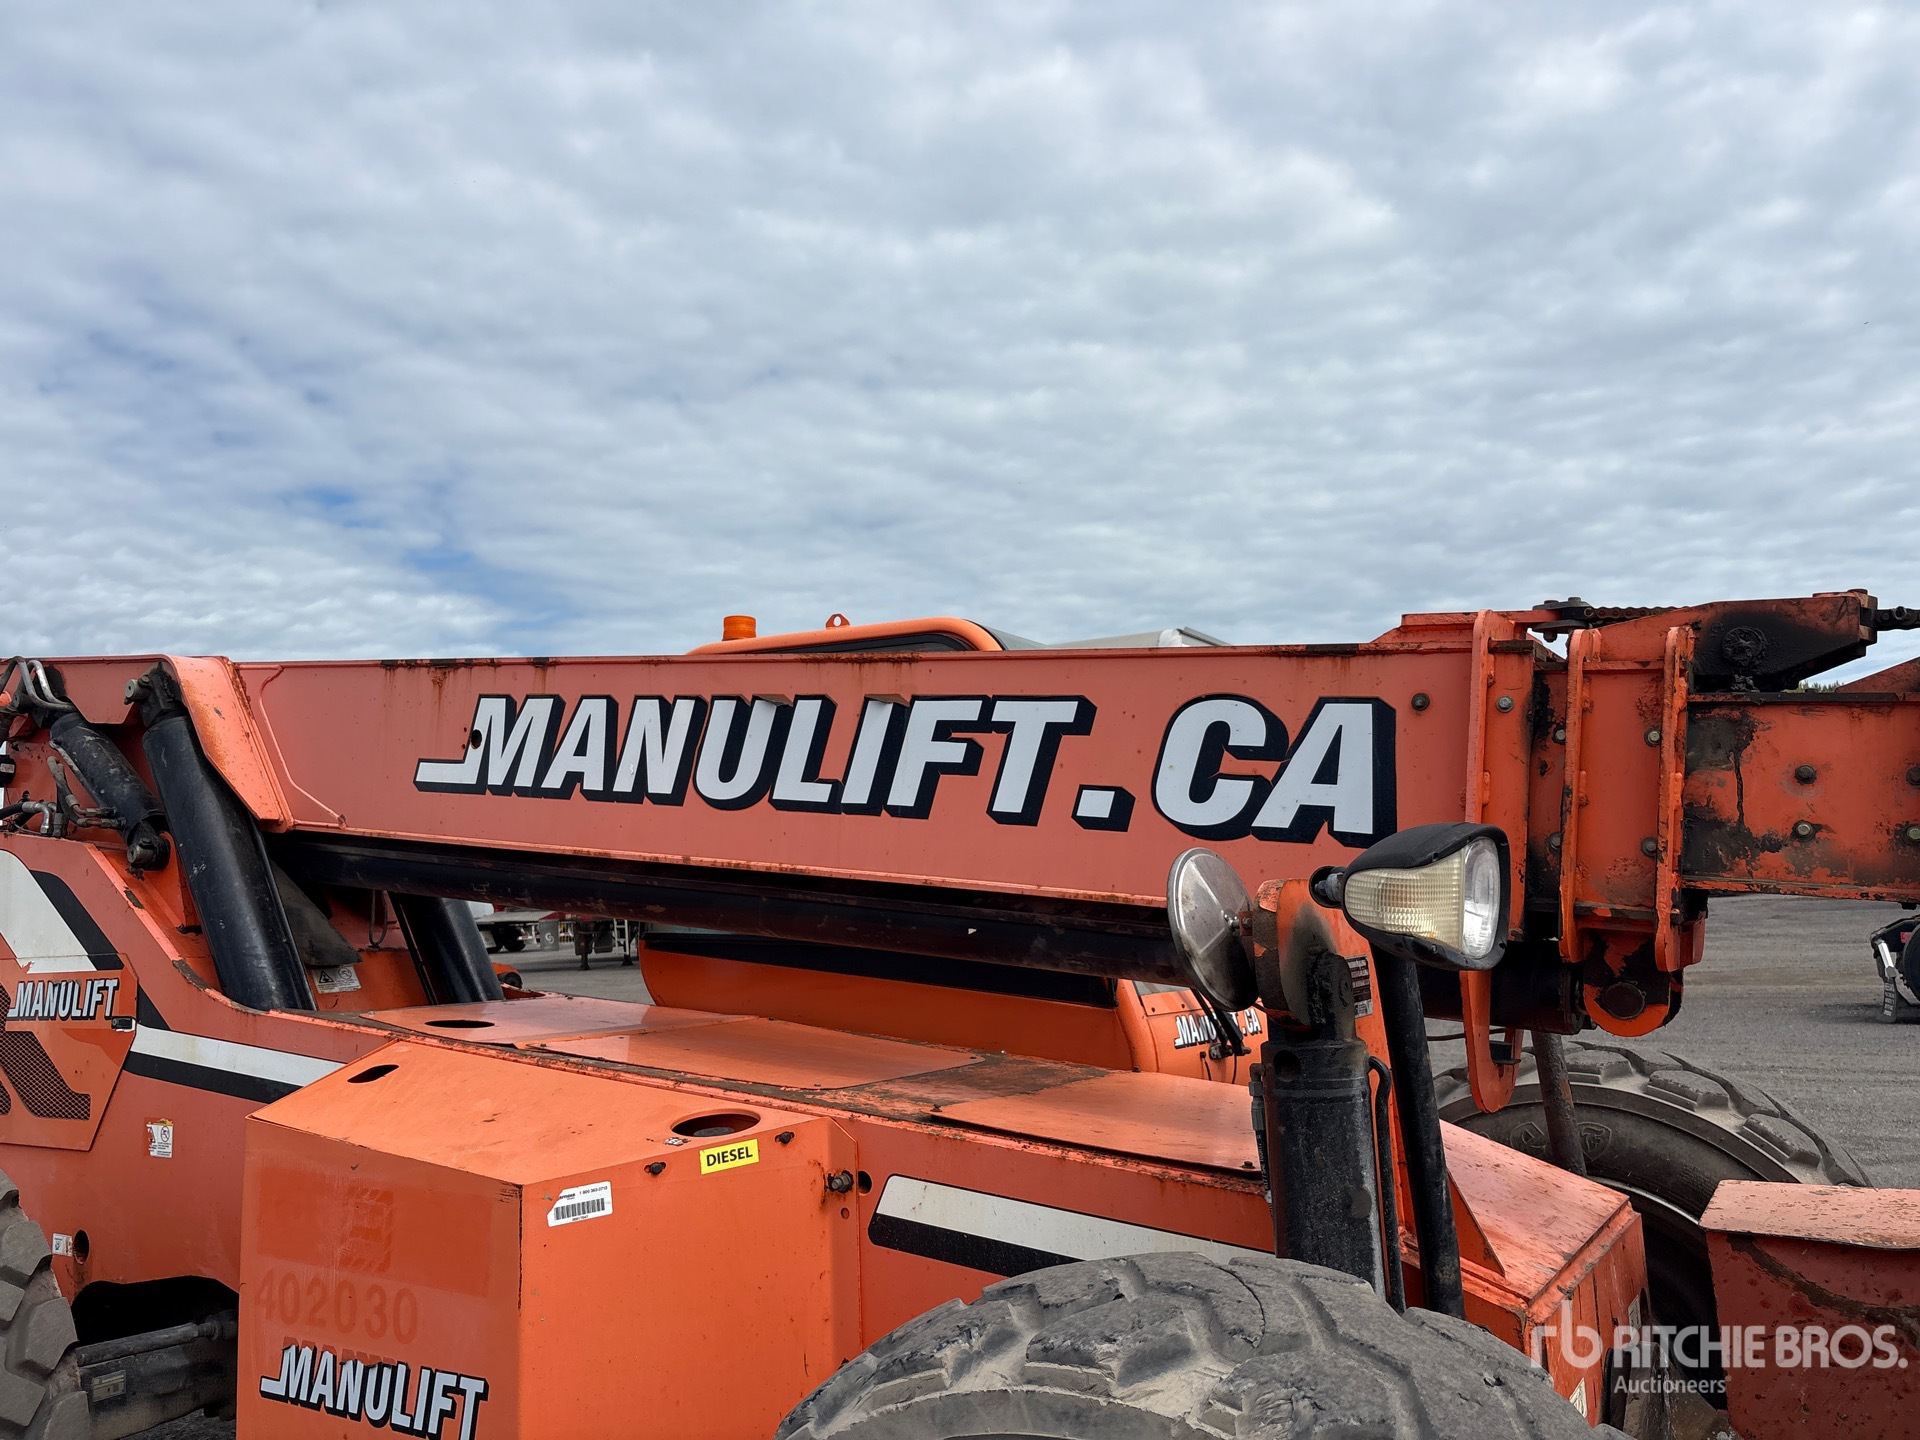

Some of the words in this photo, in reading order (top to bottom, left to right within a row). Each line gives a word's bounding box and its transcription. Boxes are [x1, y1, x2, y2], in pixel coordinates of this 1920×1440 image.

[414, 694, 1397, 848] MANULIFT.CA
[6, 978, 120, 1020] MANULIFT
[706, 1146, 753, 1167] DIESEL
[256, 1268, 418, 1345] 402030
[260, 1344, 489, 1440] MANULIFT
